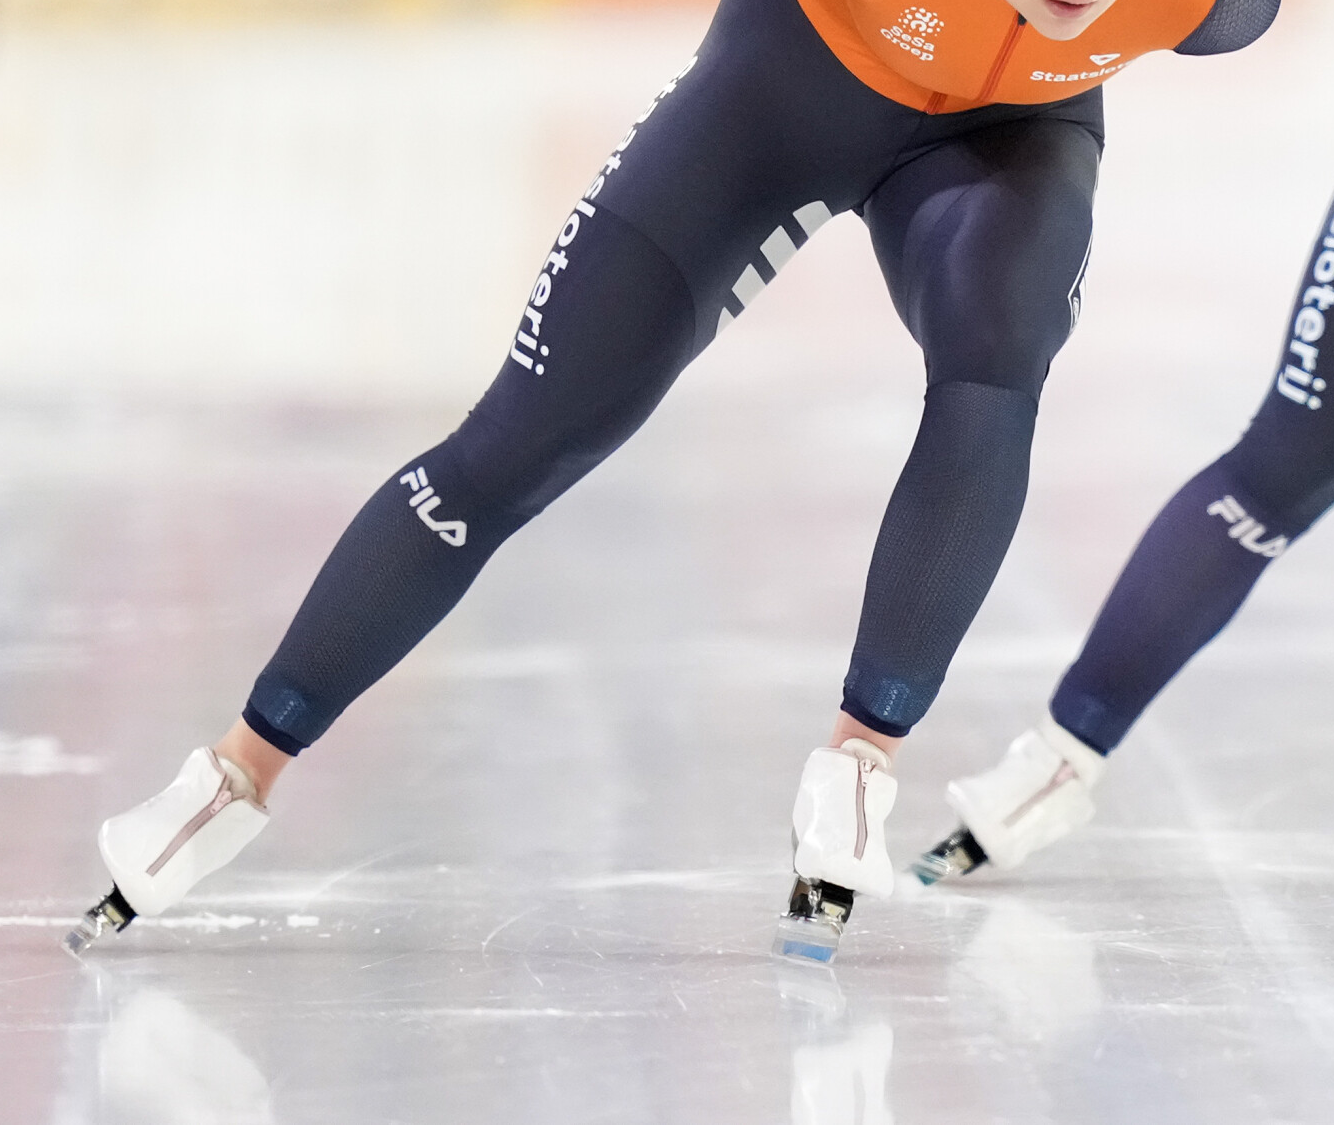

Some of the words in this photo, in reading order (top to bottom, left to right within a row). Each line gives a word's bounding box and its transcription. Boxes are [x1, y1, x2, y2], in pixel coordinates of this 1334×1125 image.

[880, 27, 934, 61] Groep
[890, 25, 935, 52] SeSa
[399, 466, 467, 547] FILA
[1207, 494, 1289, 558] FILA
